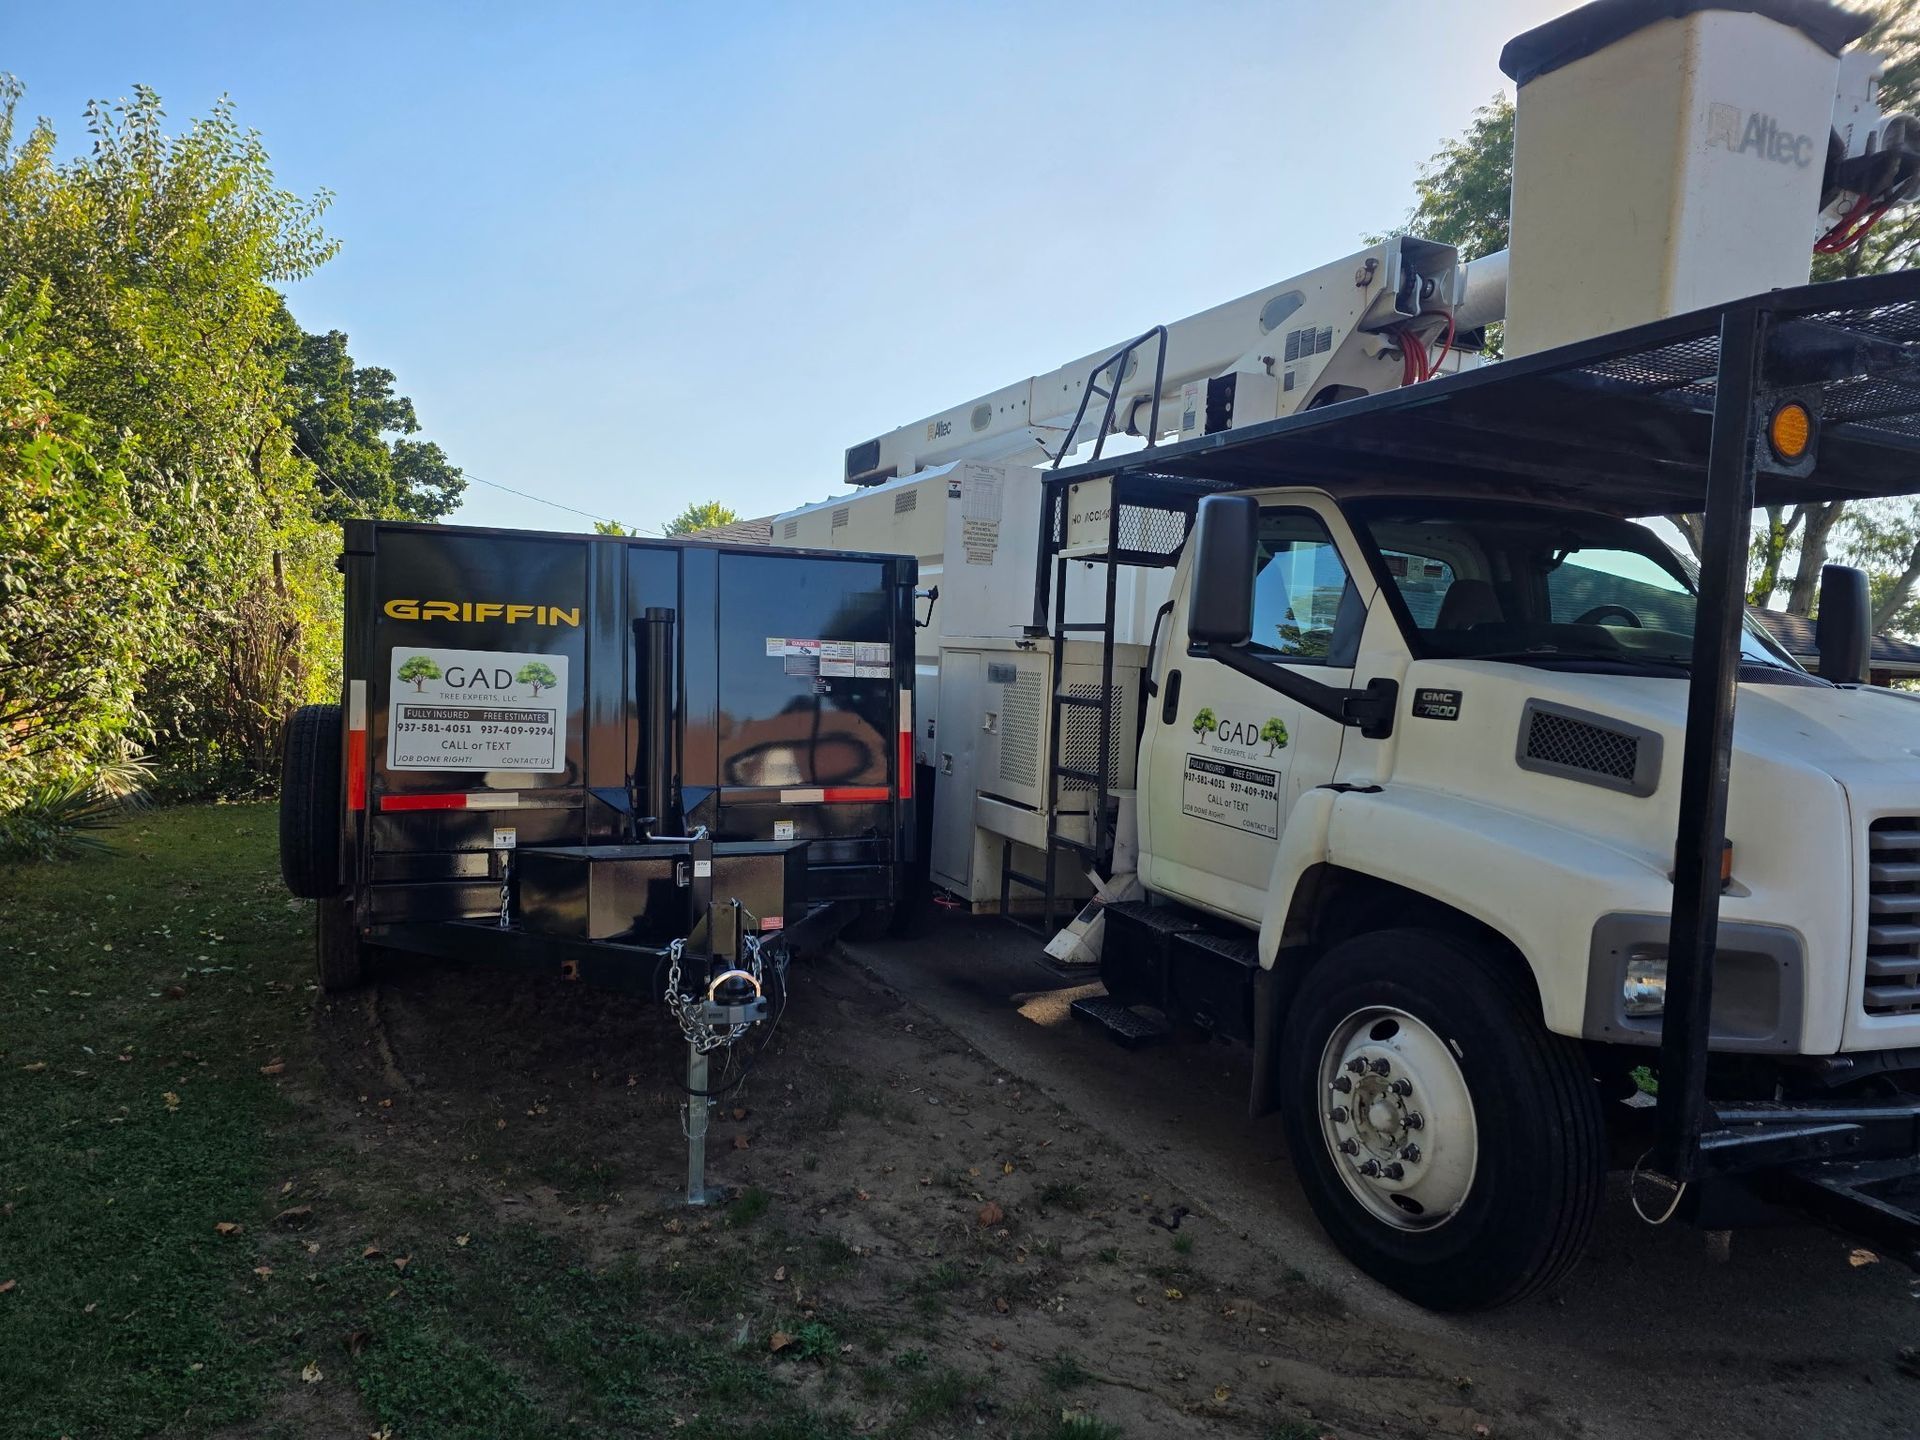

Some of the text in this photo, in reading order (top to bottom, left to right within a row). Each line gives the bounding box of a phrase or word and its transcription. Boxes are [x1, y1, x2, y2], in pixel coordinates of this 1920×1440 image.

[1740, 112, 1813, 168] Altec
[934, 421, 951, 439] Altec
[1072, 514, 1082, 525] NO
[384, 599, 580, 627] GRIFFIN
[444, 666, 513, 690] GAD
[440, 692, 460, 701] TREE
[463, 693, 500, 702] EXPERTS,
[1423, 692, 1454, 702] GMC
[407, 709, 546, 722] FULLY INSURED FREE ESTIMATES
[397, 723, 553, 736] 937-581-4051 937-409-9294
[1218, 719, 1259, 746] GAD
[441, 740, 511, 751] CALL or TEXT
[397, 754, 414, 762] JOB
[416, 755, 440, 763] DONE
[1211, 745, 1223, 754] TREE
[1248, 752, 1258, 761] LLC
[1190, 760, 1274, 785] FULLY INSURED FREE ESTIMATES
[1184, 772, 1278, 801] 937-581-4051 937-409-9294
[1207, 794, 1249, 812] CALL or TEXT
[1194, 806, 1208, 815] DONE
[1242, 820, 1267, 832] CONTACT
